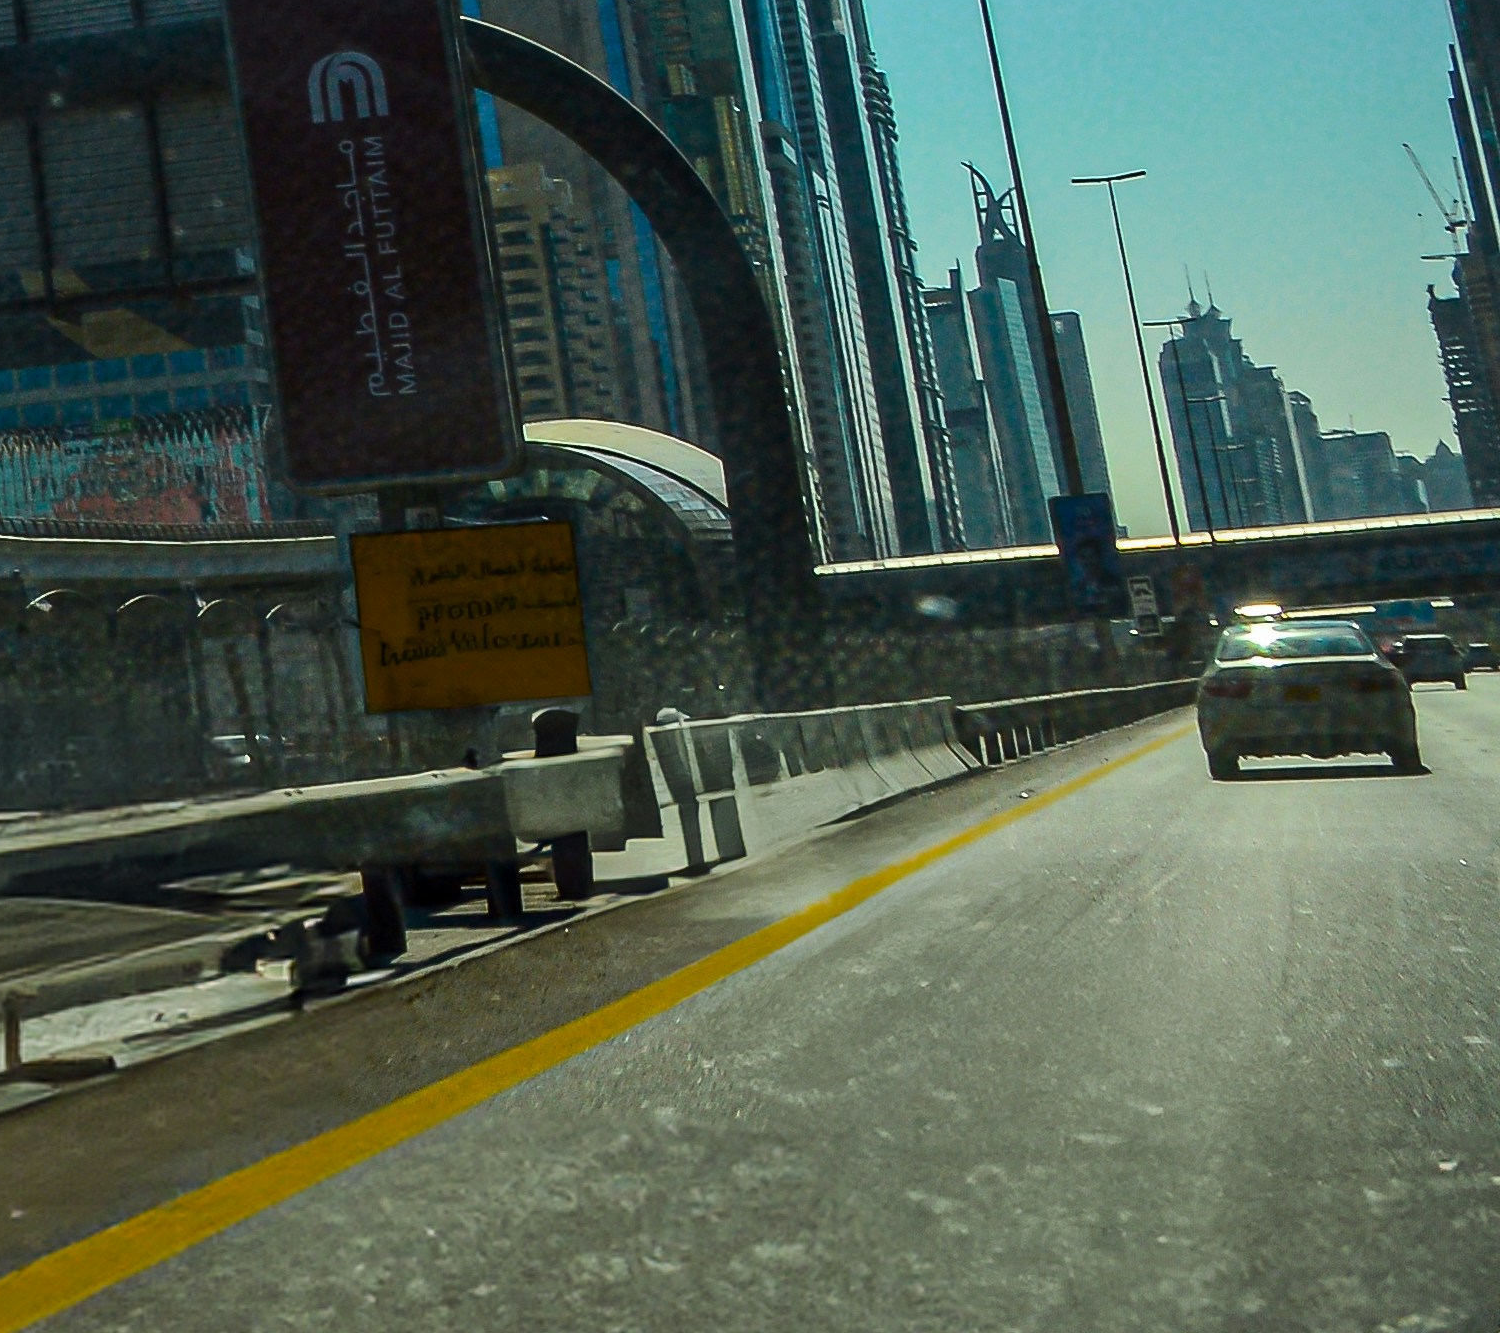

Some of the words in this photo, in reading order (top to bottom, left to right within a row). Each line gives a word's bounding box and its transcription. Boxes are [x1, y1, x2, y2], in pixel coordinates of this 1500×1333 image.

[334, 138, 369, 237] ماجد
[363, 135, 399, 256] FUTTAIM
[342, 240, 393, 398] الفطيم
[382, 262, 405, 302] AL
[387, 310, 419, 396] MAJID
